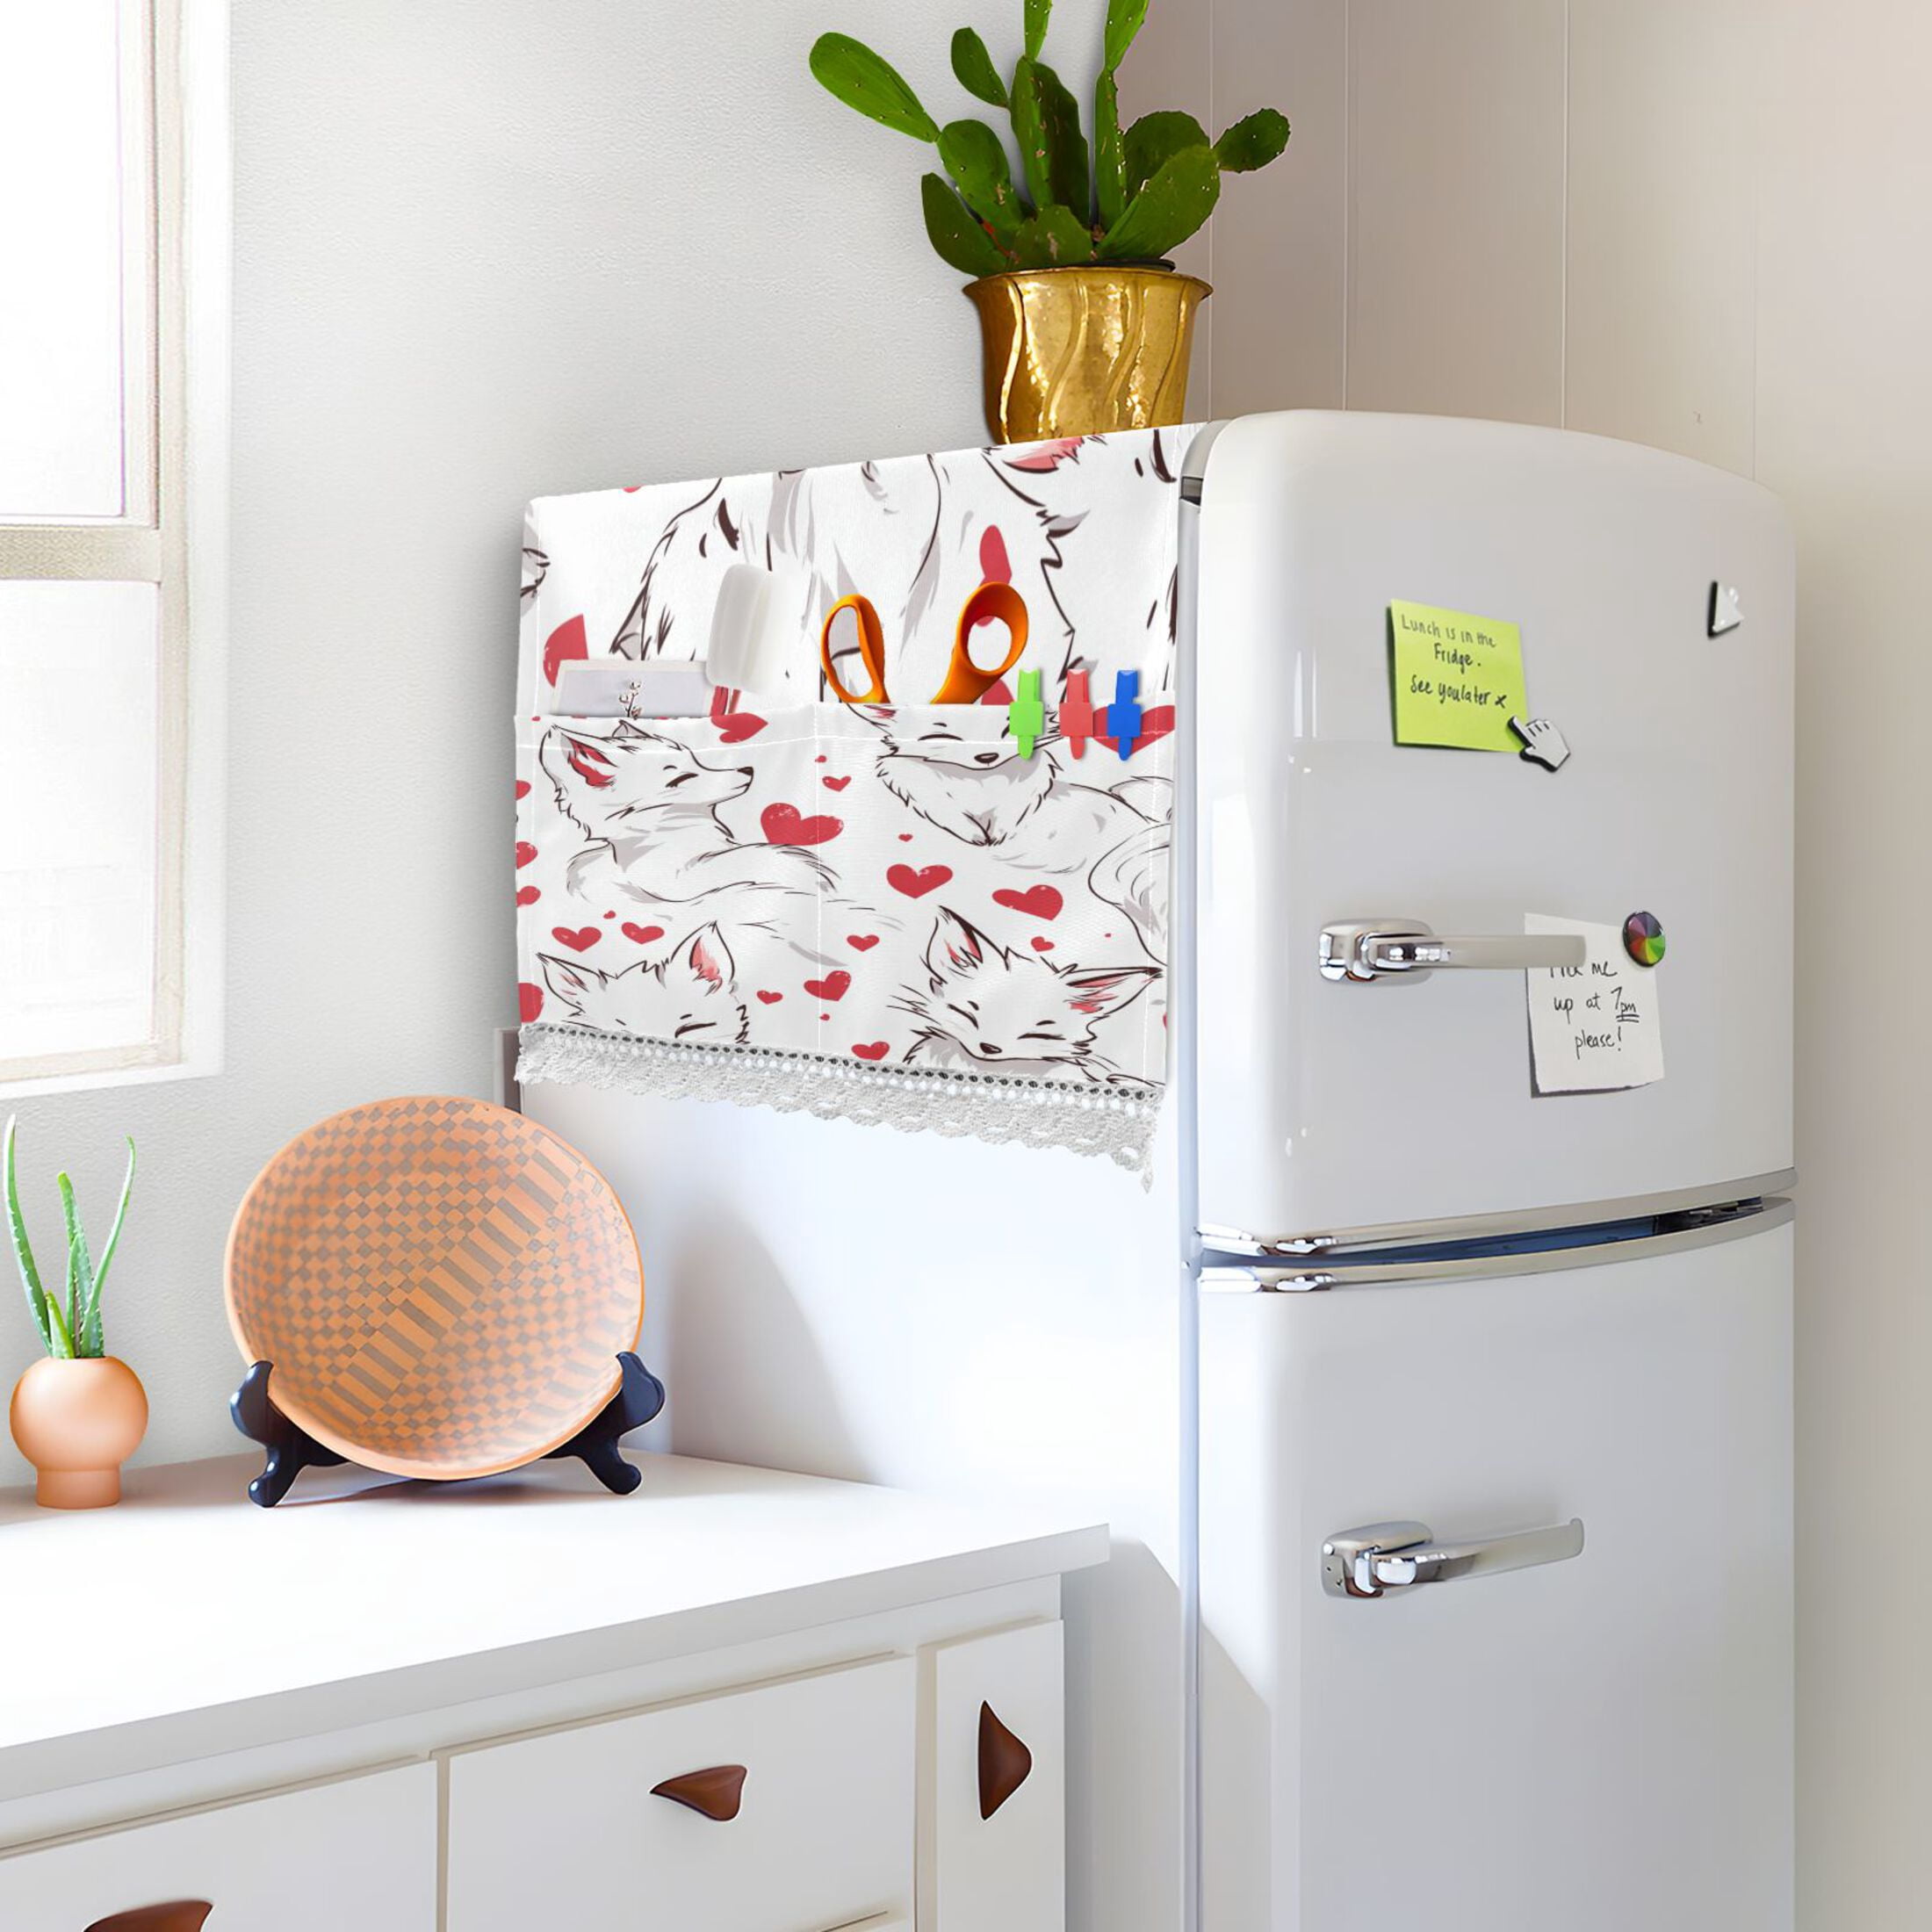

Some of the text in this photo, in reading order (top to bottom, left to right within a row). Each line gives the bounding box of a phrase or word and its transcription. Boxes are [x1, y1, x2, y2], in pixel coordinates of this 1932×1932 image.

[1402, 614, 1441, 638] Lunch
[1460, 631, 1474, 643] in
[1477, 631, 1496, 647] the
[1410, 674, 1433, 695] See
[1554, 997, 1574, 1024] up
[1586, 992, 1601, 1011] at
[1575, 1026, 1622, 1060] please!
